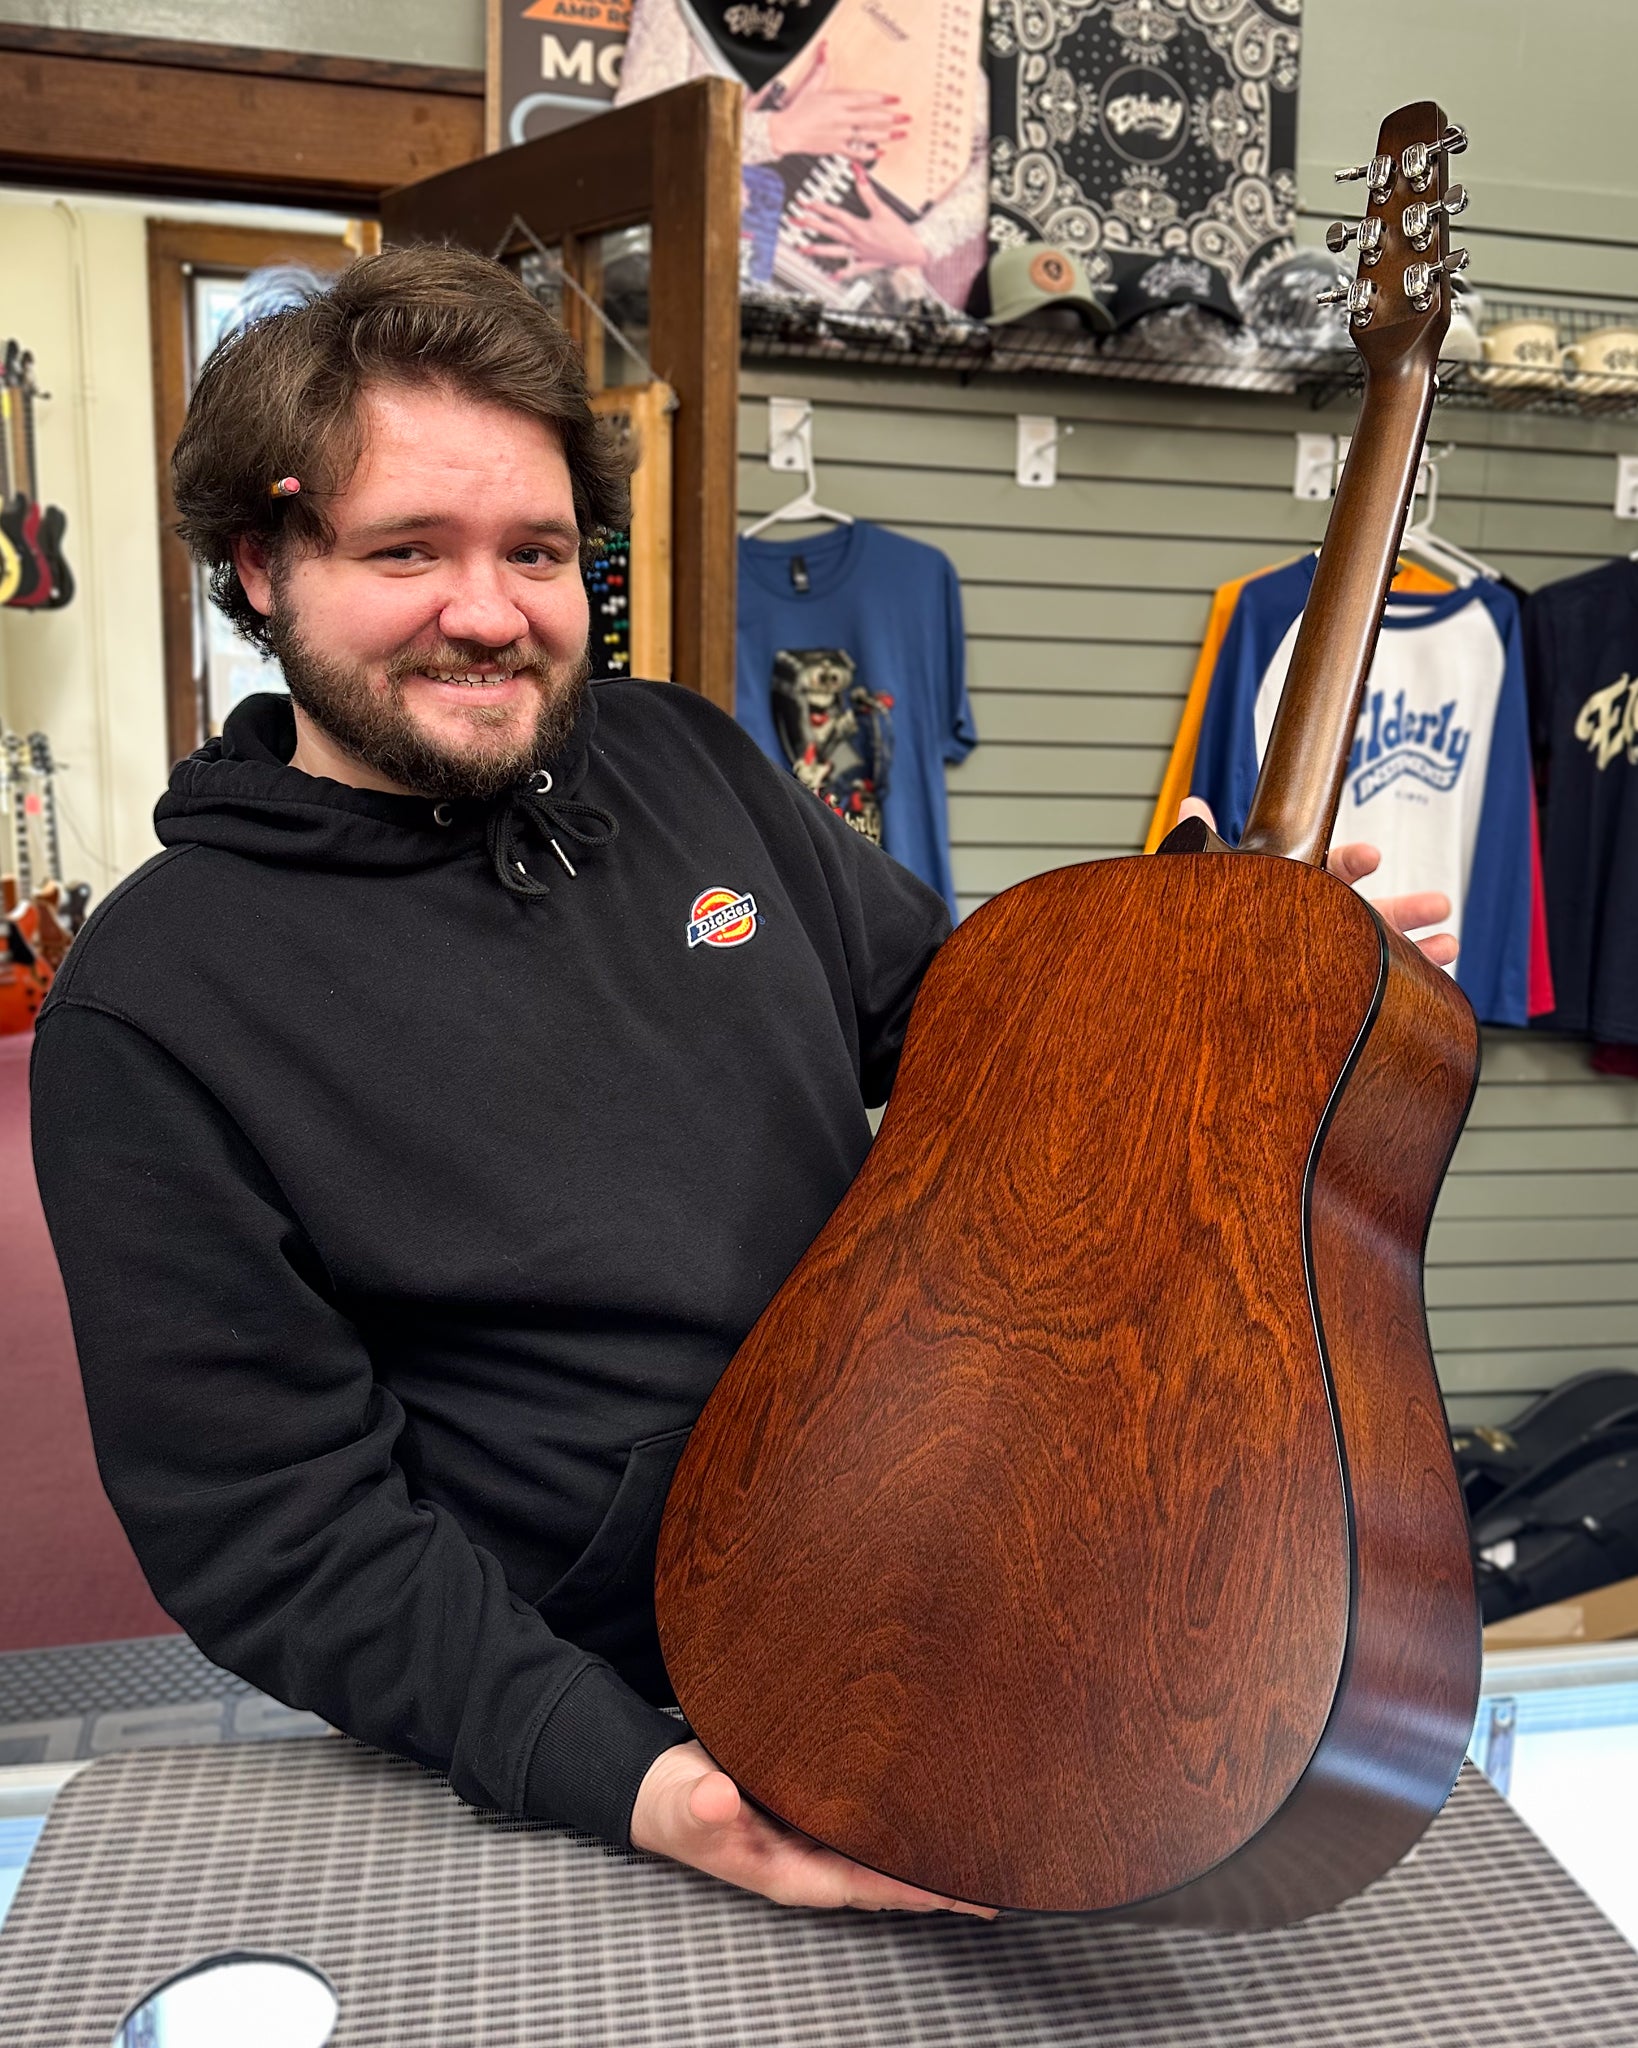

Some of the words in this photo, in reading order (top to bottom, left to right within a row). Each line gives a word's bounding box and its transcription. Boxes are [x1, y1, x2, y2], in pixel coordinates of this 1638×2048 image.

[553, 2, 601, 18] AMP
[1574, 672, 1638, 771] El
[696, 902, 750, 937] Dickies
